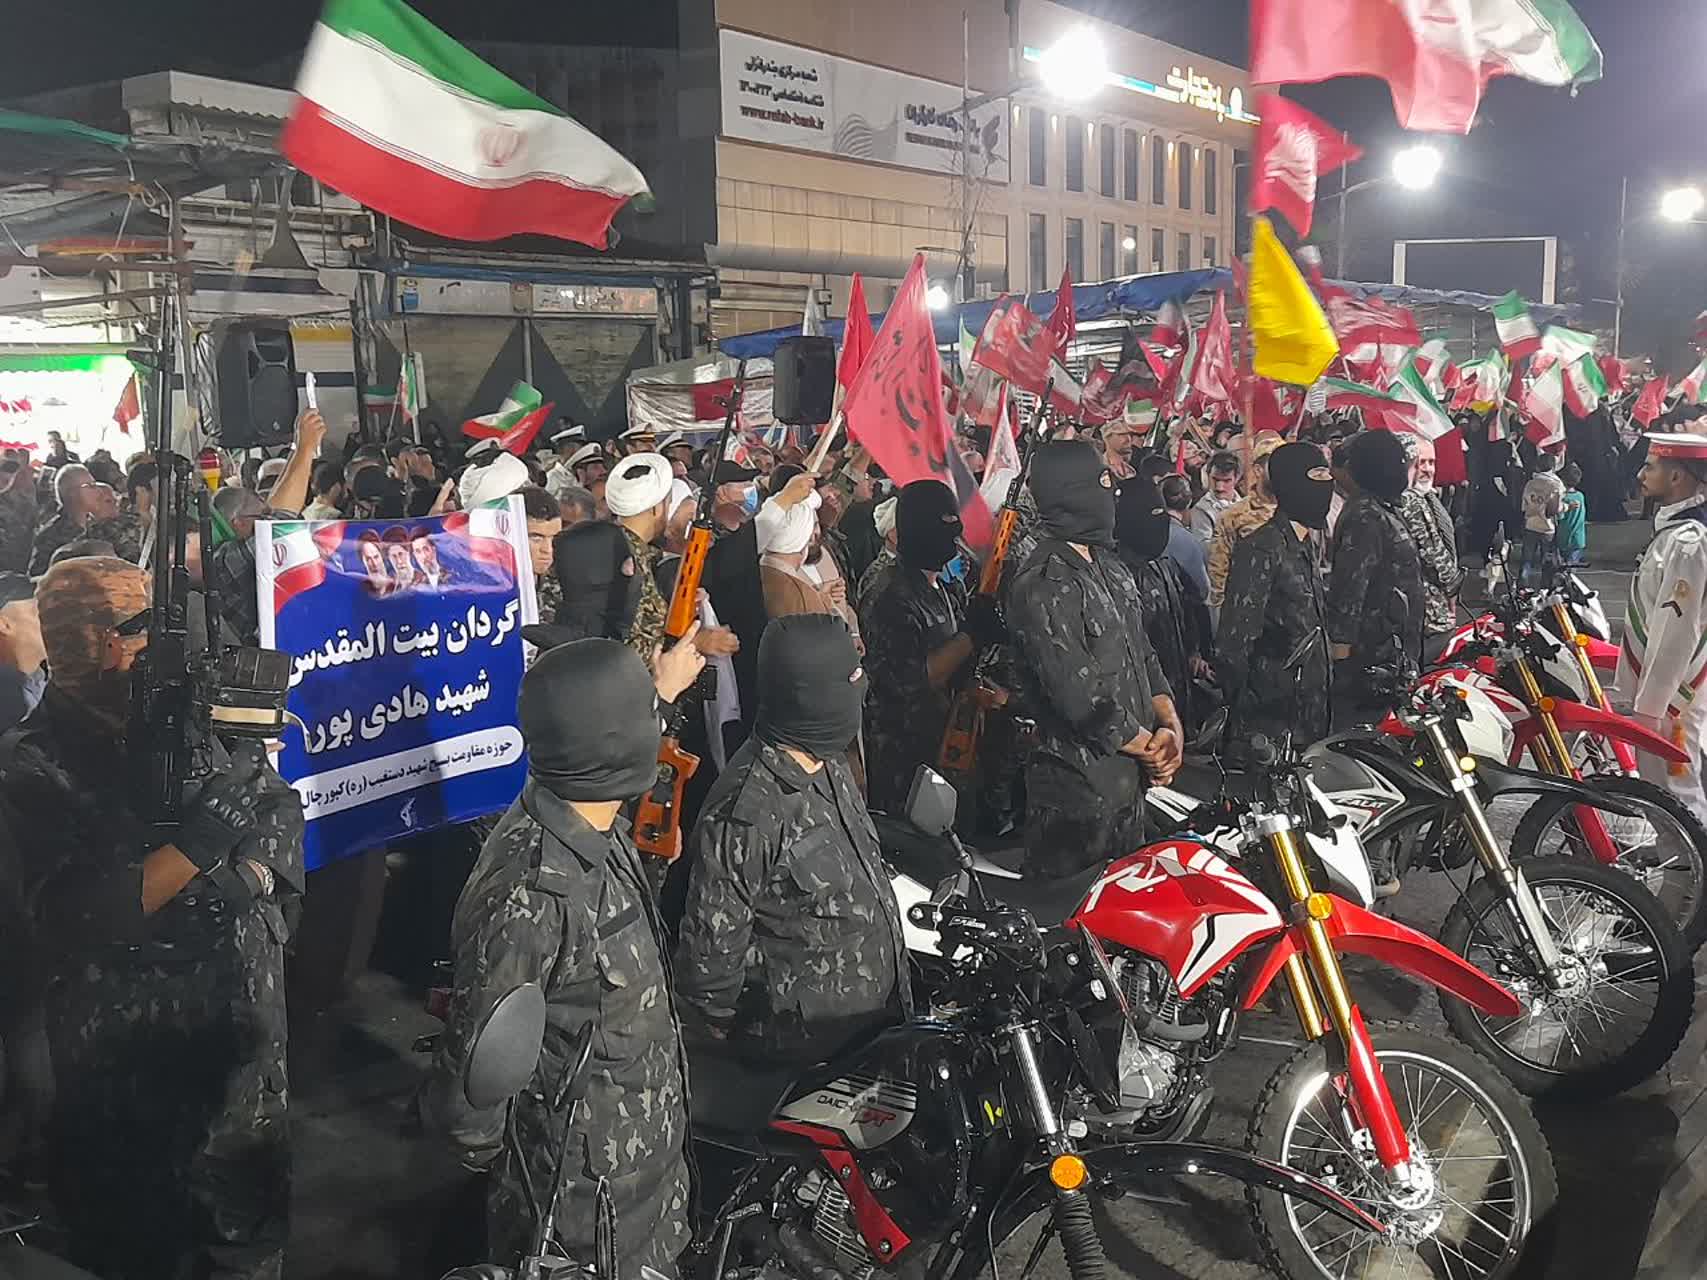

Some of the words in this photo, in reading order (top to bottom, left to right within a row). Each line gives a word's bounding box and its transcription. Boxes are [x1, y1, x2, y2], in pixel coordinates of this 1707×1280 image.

[393, 622, 440, 657] بیت
[446, 598, 519, 654] گردان
[288, 620, 386, 688] المقدس
[360, 684, 430, 740] هادی
[435, 668, 490, 716] شهید
[311, 708, 354, 754] پور
[452, 744, 485, 763] مقاومت
[487, 741, 513, 757] حوزه
[406, 758, 427, 777] شهید
